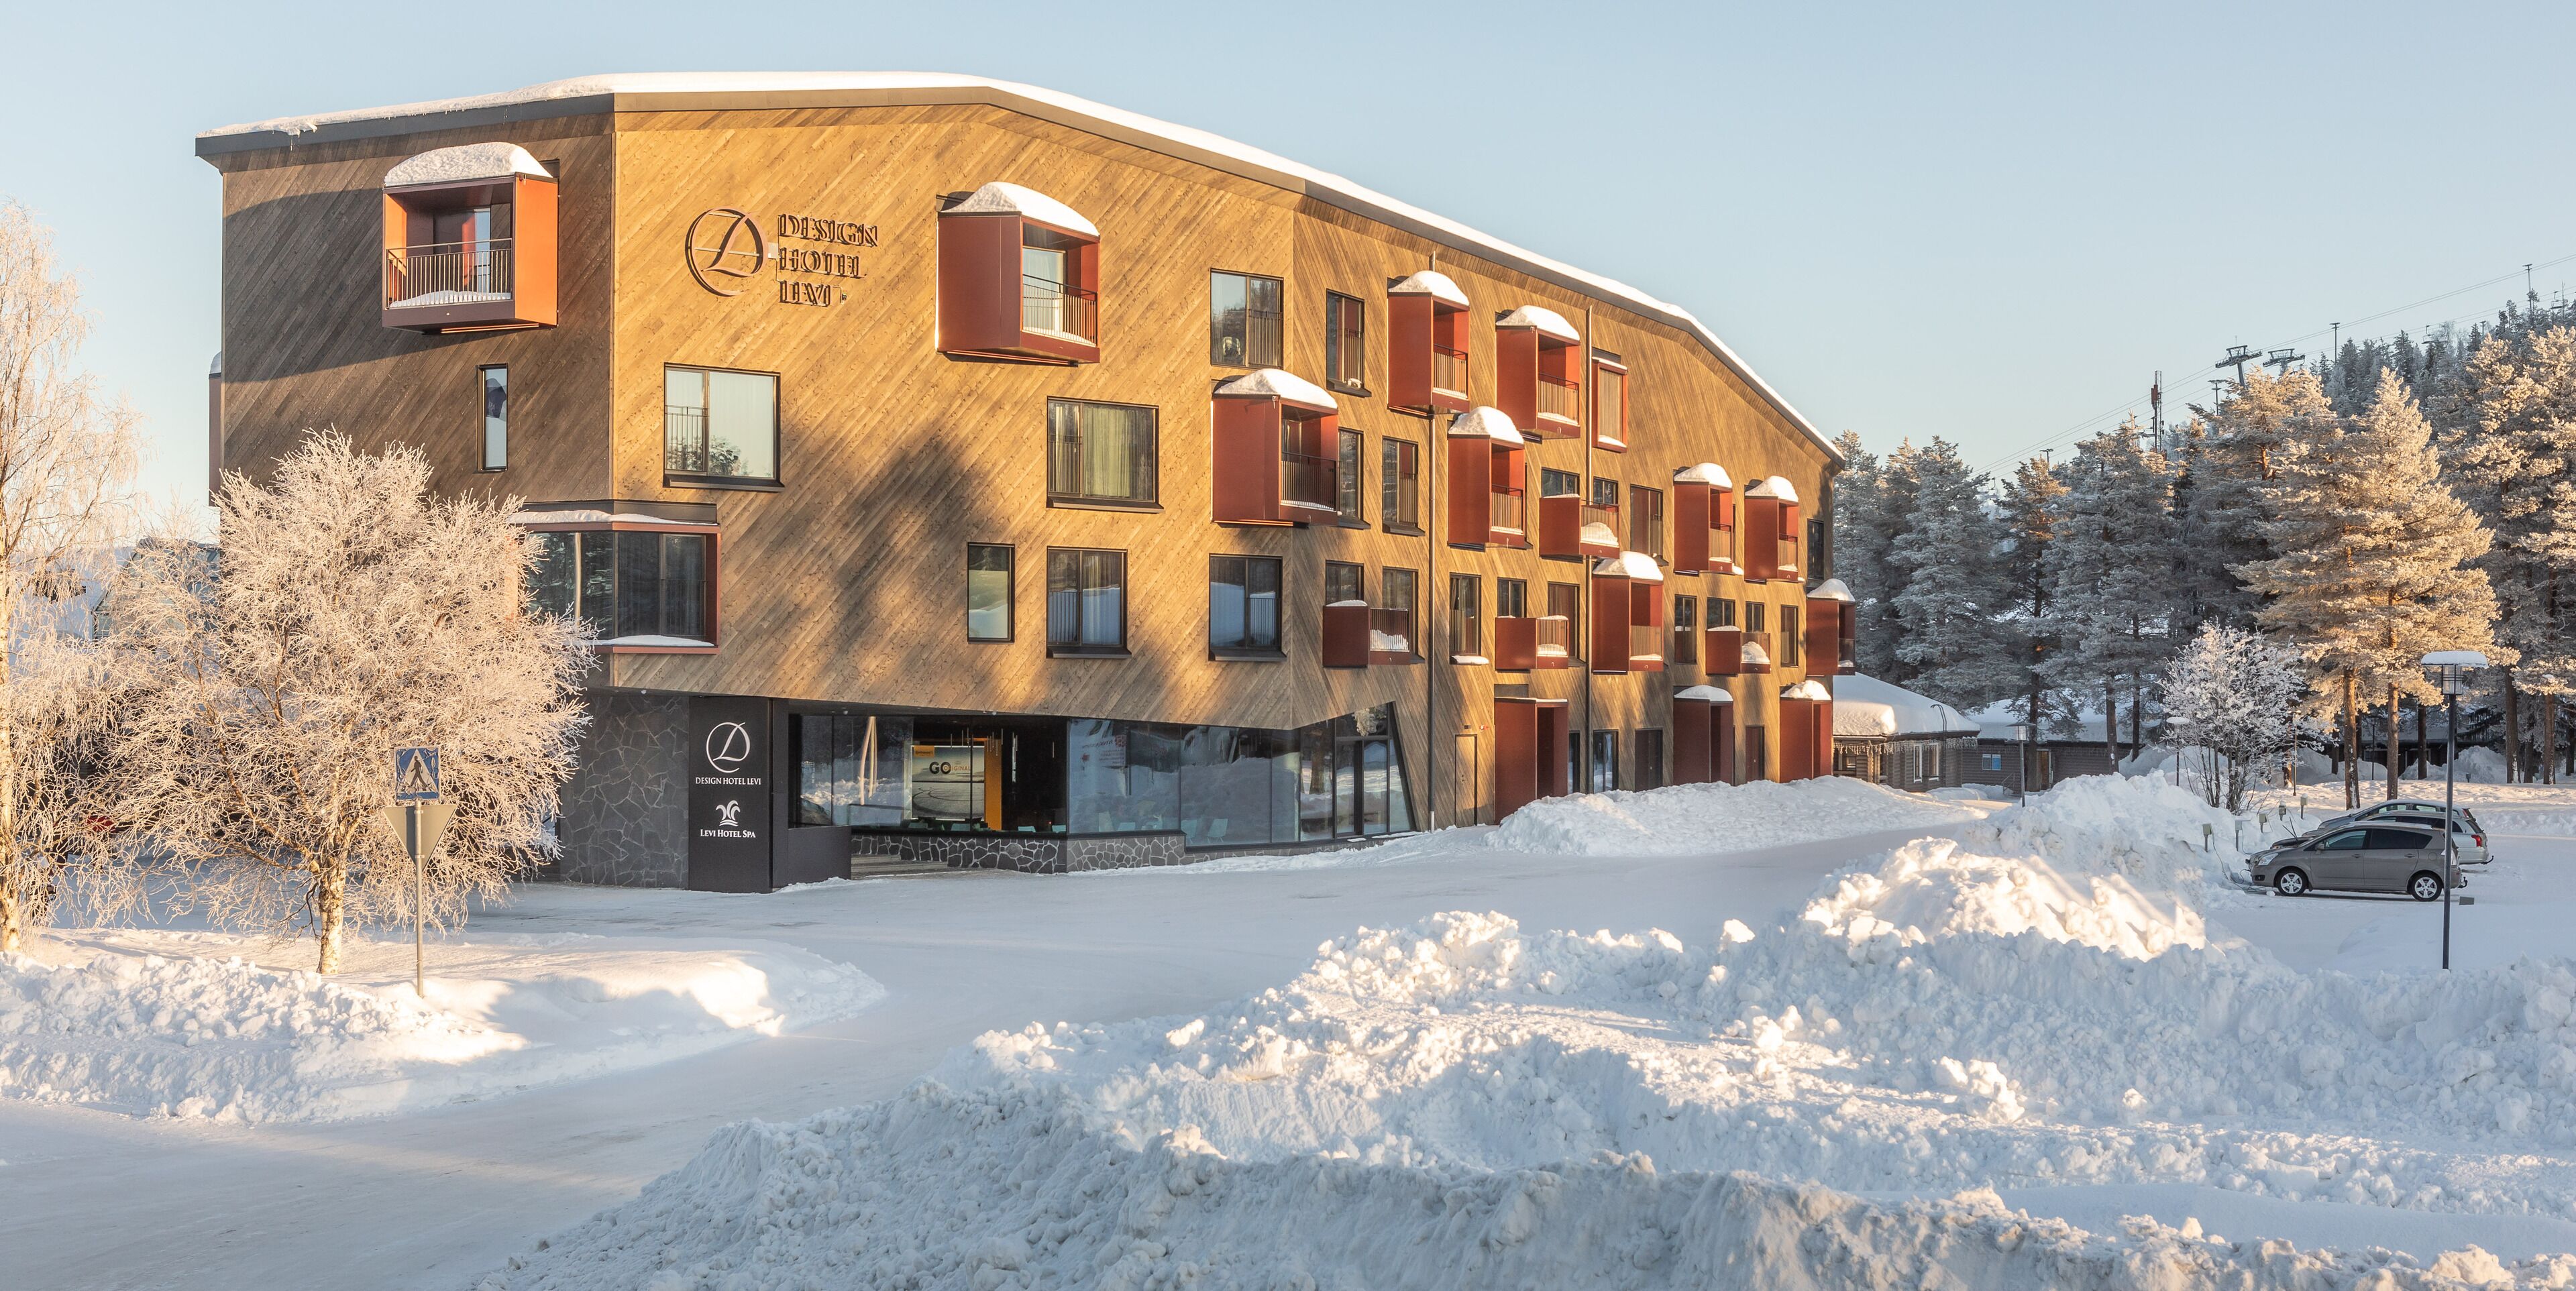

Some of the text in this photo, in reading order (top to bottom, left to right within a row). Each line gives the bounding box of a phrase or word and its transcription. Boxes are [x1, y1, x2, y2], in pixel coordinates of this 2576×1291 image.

[777, 213, 878, 247] DESIGN
[778, 247, 867, 279] HOTEL
[779, 280, 831, 307] LEVI
[929, 761, 951, 775] GO
[695, 777, 722, 785] DESIGN
[722, 777, 746, 785] HOTEL
[700, 829, 756, 838] LEVI HOTEL SPA
